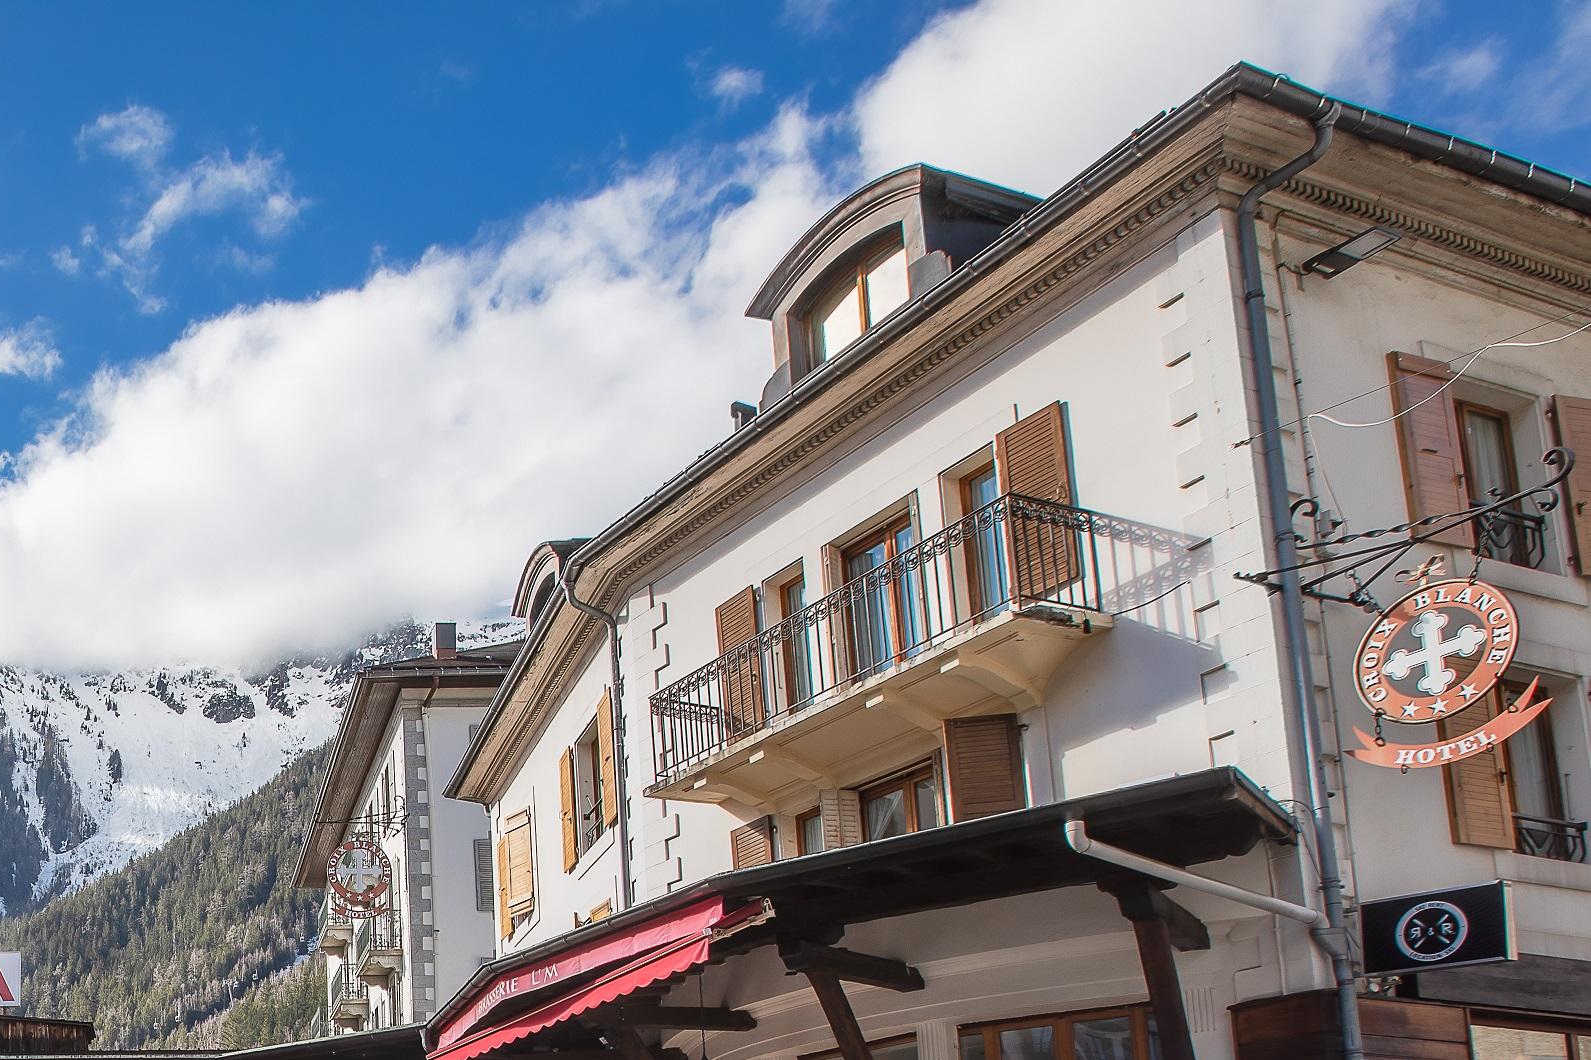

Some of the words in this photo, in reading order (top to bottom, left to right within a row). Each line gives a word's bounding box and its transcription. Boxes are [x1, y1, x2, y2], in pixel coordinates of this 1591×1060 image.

[1363, 618, 1398, 702] CROIX
[1413, 587, 1512, 665] BLANCHE
[1394, 729, 1497, 765] HOTEL
[328, 845, 347, 883] CROIX
[353, 841, 391, 884] BLANCHE
[344, 910, 378, 918] HOTEL
[477, 977, 519, 1015] BRASSERIE
[531, 963, 559, 986] L'M
